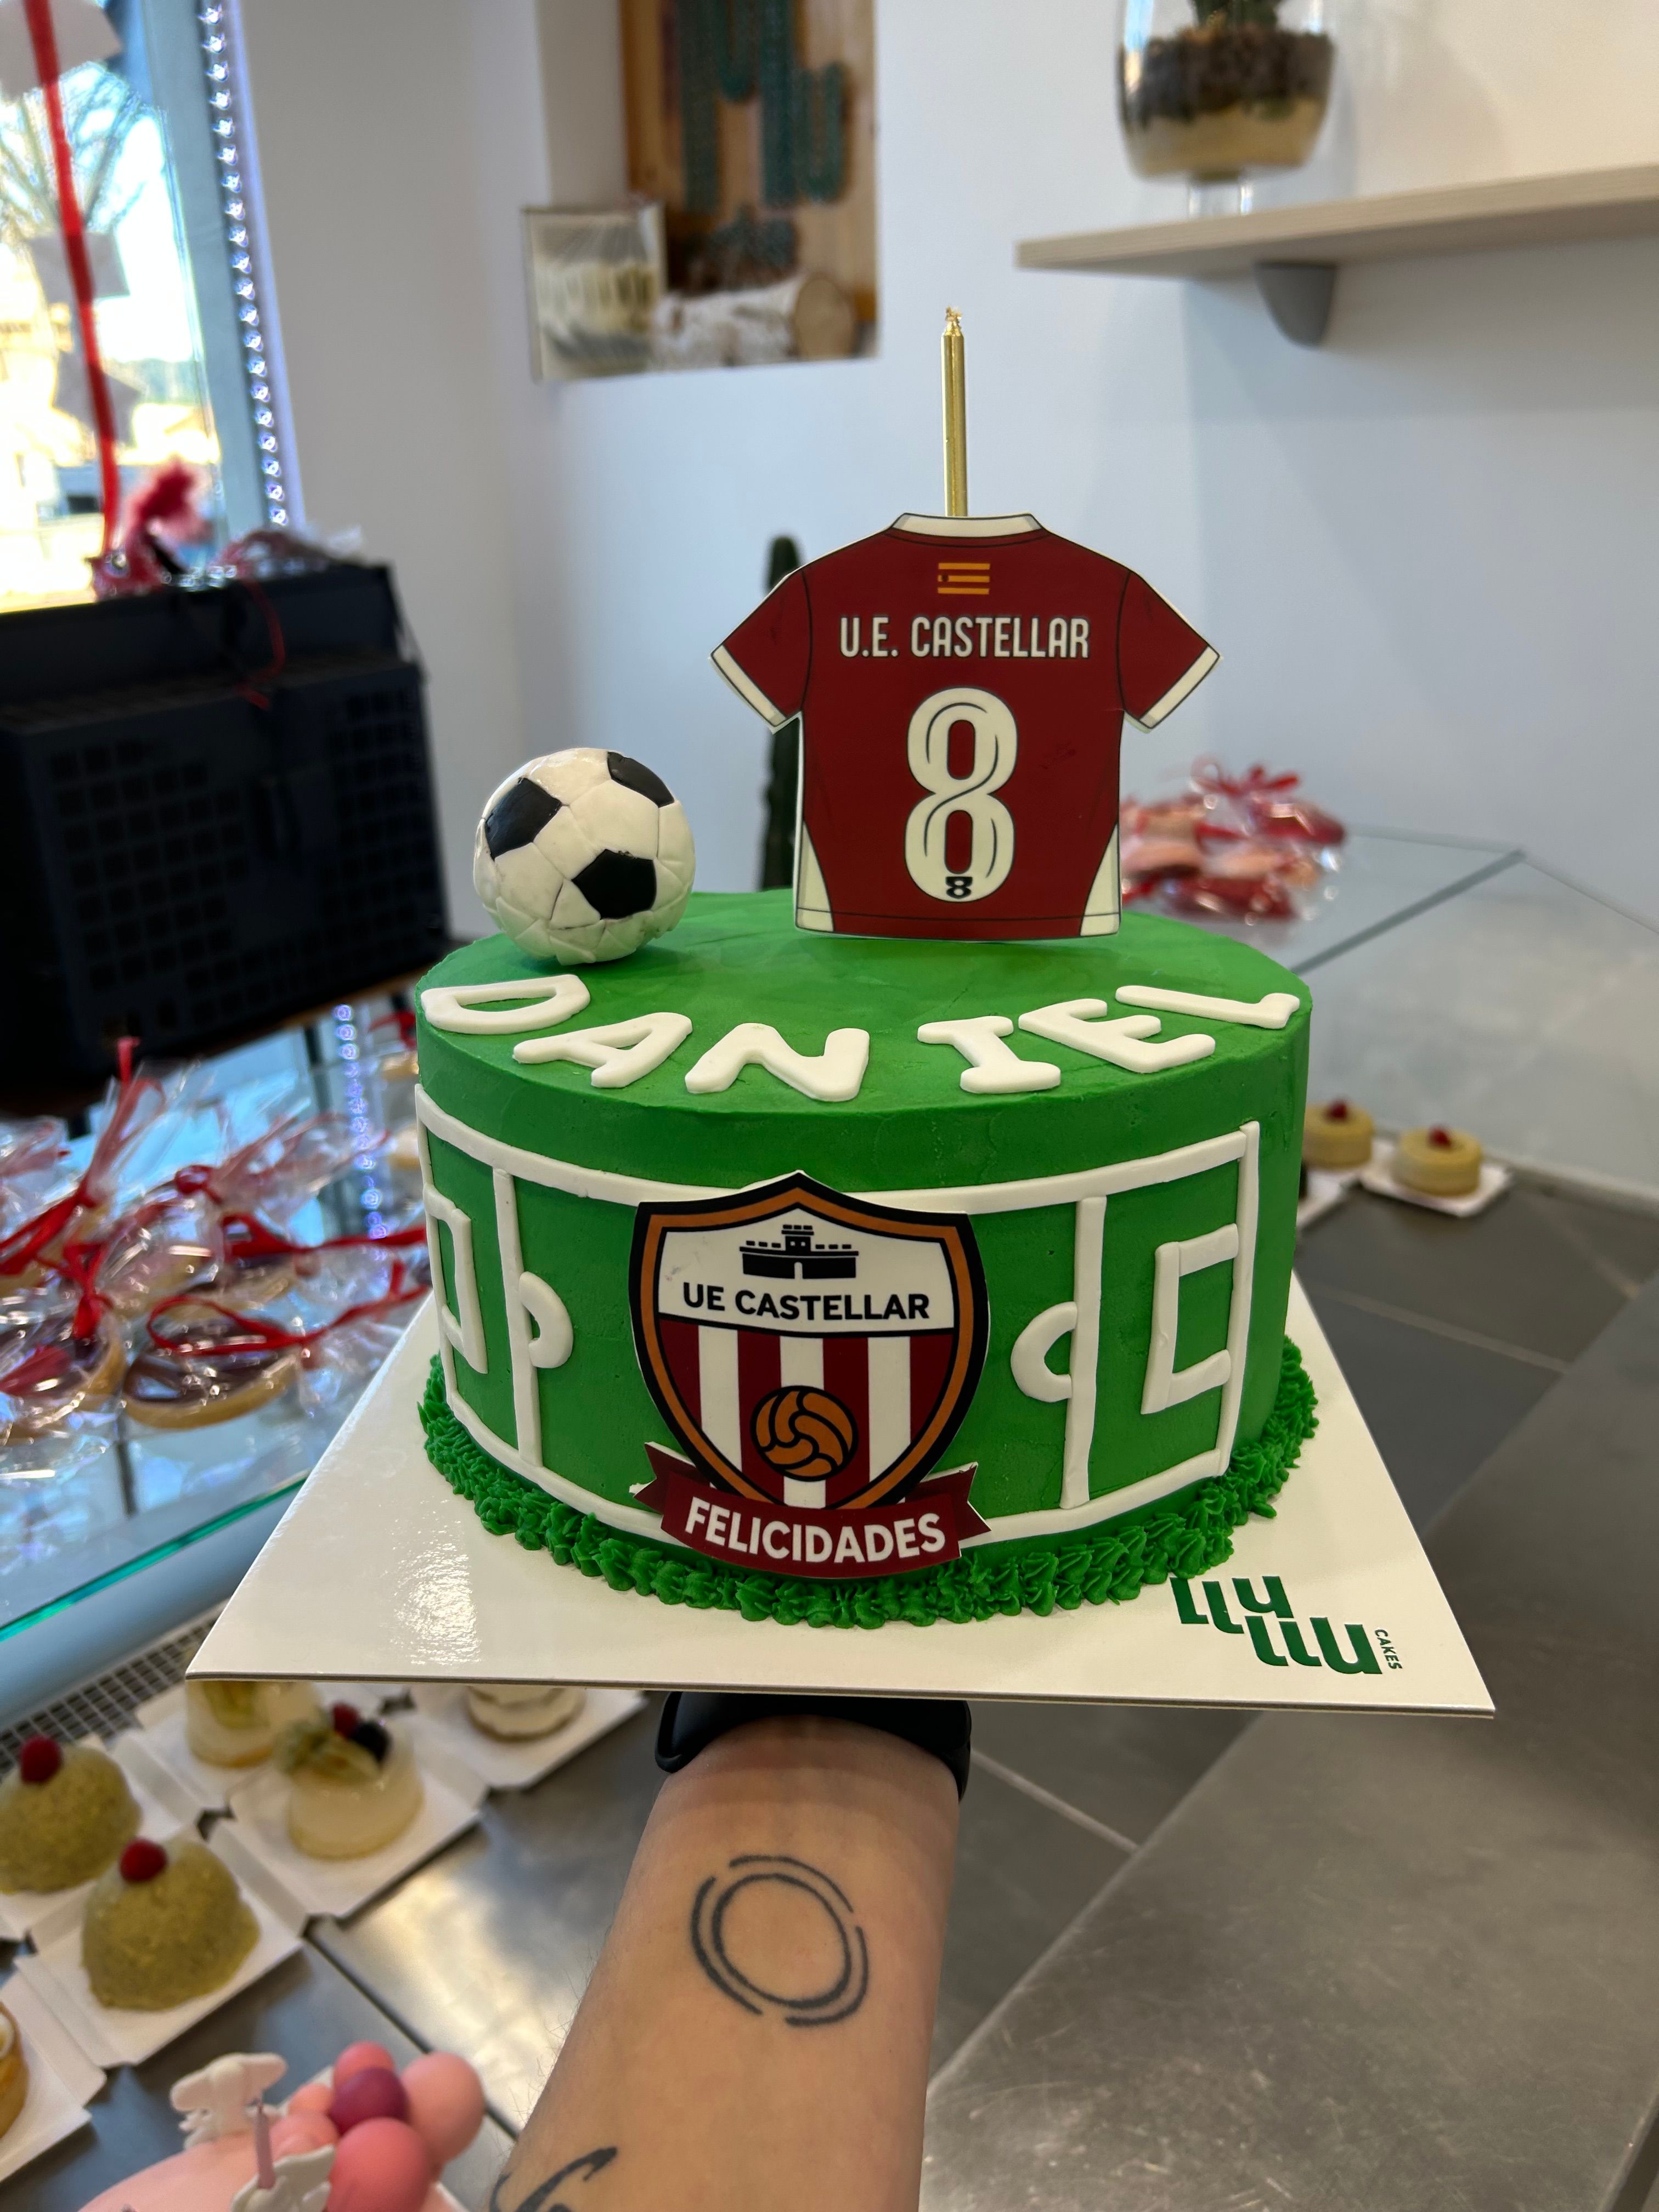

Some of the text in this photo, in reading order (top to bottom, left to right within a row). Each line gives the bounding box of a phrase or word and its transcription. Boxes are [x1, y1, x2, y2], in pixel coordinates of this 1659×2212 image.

[840, 617, 1091, 658] U.E. CASTELLAR
[905, 687, 1018, 902] 8
[420, 974, 1302, 1102] DANIEL
[682, 1282, 929, 1321] UE CASTELLAR
[685, 1497, 946, 1564] FELICIDADES
[1375, 1629, 1402, 1670] CAKES
